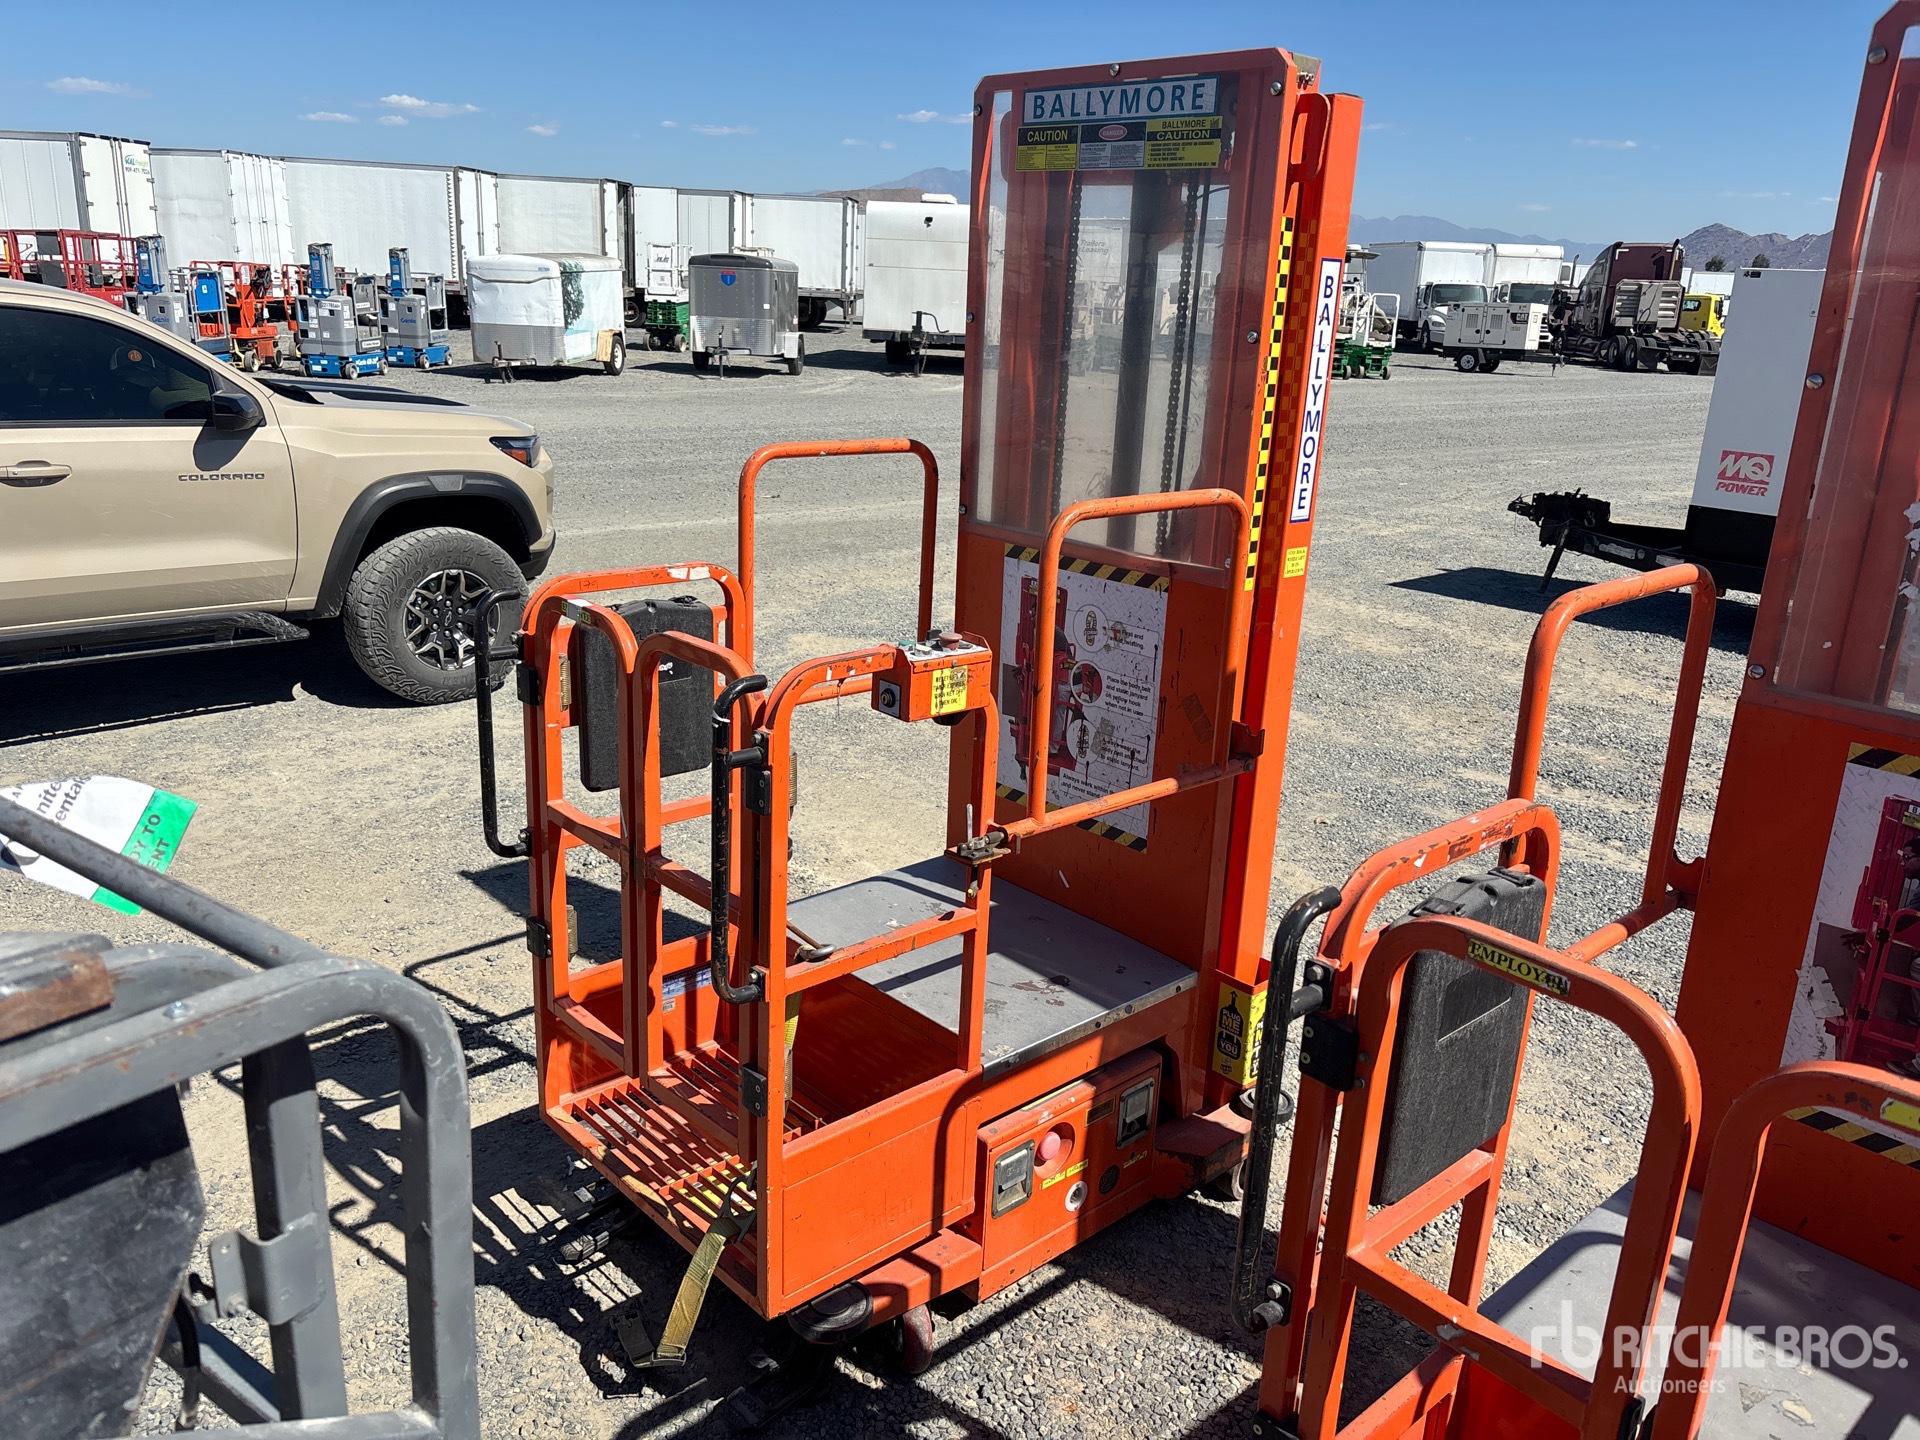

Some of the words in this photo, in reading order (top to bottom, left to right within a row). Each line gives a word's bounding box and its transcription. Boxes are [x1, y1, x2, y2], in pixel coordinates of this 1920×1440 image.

[1032, 82, 1206, 119] BALLYMORE
[1162, 120, 1206, 129] BALLYMORE
[1027, 129, 1068, 142] CAUTION
[1156, 130, 1210, 140] CAUTION
[1081, 246, 1109, 255] Leasing
[1516, 313, 1529, 321] CAT
[1296, 274, 1335, 512] BALLYMORE
[1717, 453, 1771, 482] MQ
[178, 473, 265, 481] COLORADO
[1715, 481, 1768, 496] POWER
[1107, 675, 1119, 683] Place
[1129, 682, 1140, 691] body
[1141, 685, 1151, 693] belt
[1105, 701, 1118, 709] when
[1113, 695, 1128, 704] yellow
[1129, 699, 1141, 707] hook
[1063, 773, 1080, 784] Always
[1081, 780, 1093, 788] work
[1094, 785, 1108, 793] within
[1086, 789, 1100, 798] stand
[142, 813, 161, 835] TO
[1222, 1008, 1241, 1021] PLUG
[1222, 1017, 1241, 1031] ME
[1220, 1040, 1238, 1055] YOU
